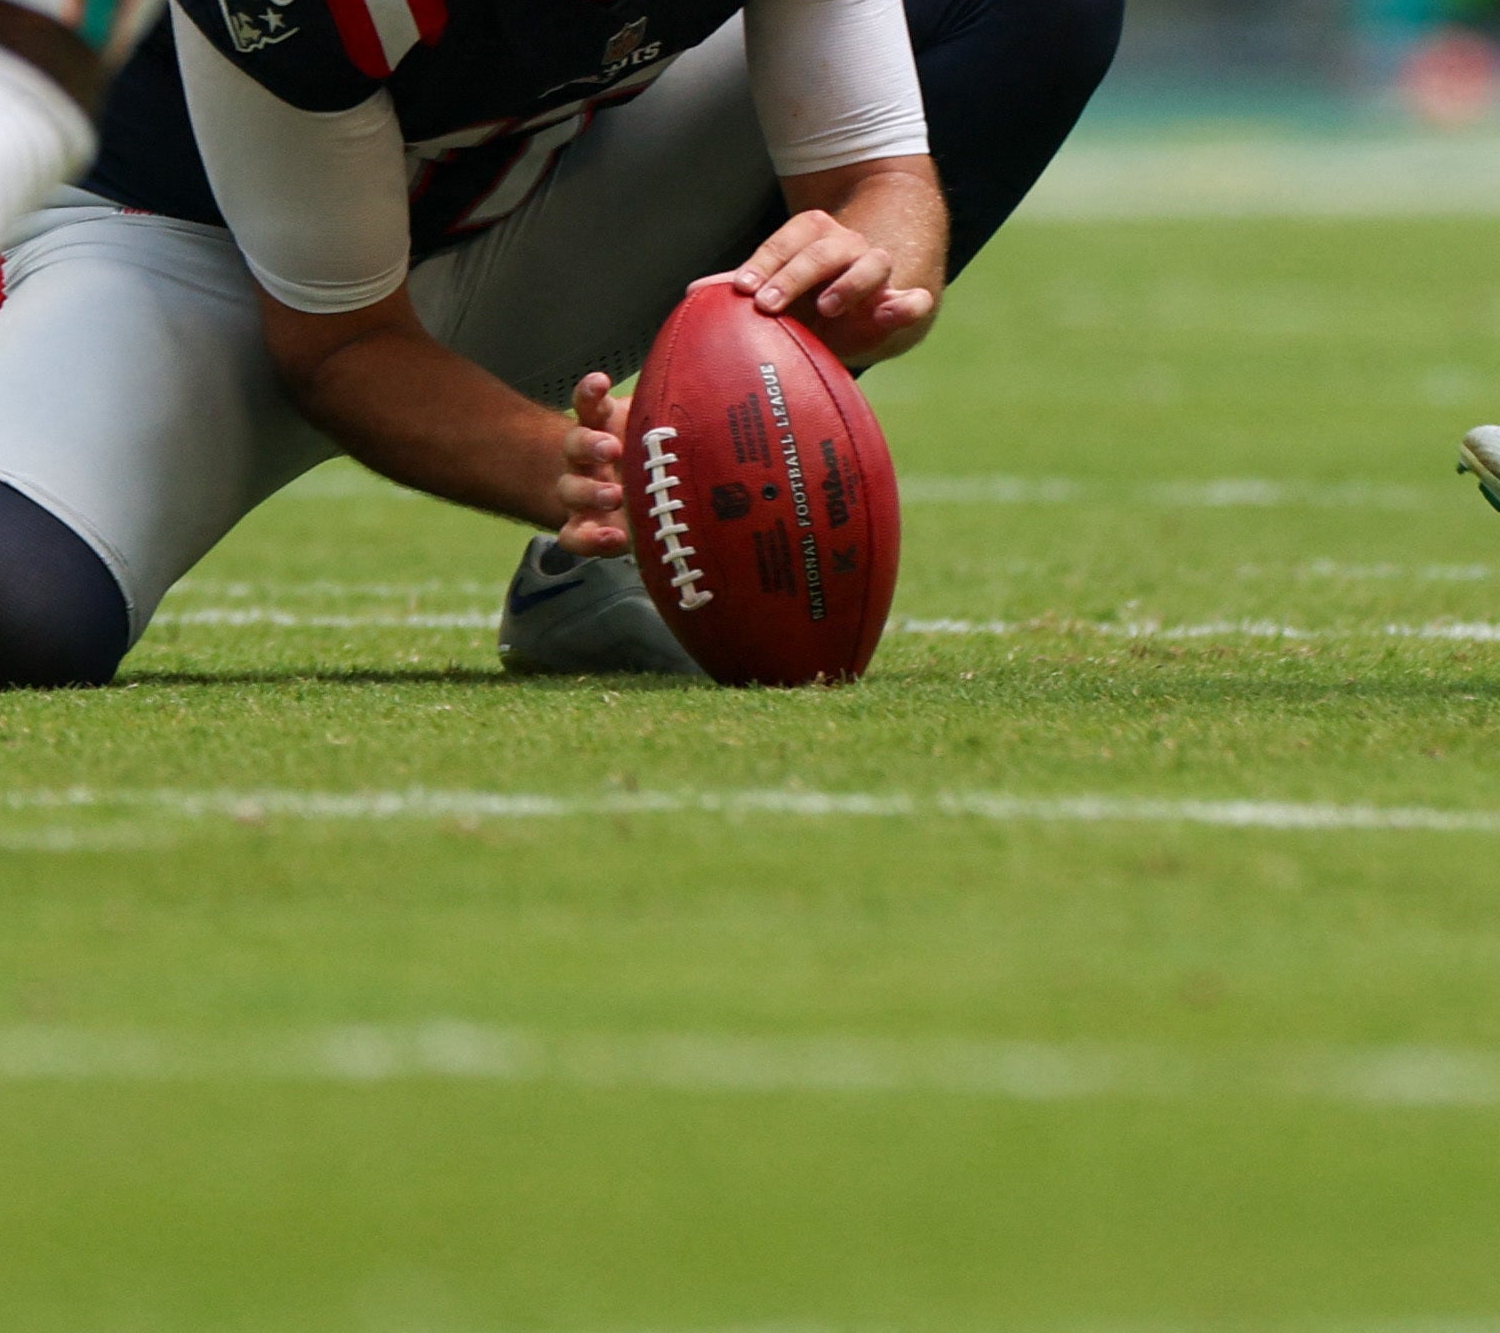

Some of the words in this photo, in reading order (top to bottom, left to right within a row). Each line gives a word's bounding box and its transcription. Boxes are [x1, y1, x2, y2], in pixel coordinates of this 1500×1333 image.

[759, 362, 790, 428] LEAGUE
[779, 433, 812, 528] FOOTBALL
[802, 534, 826, 620] NATIONAL
